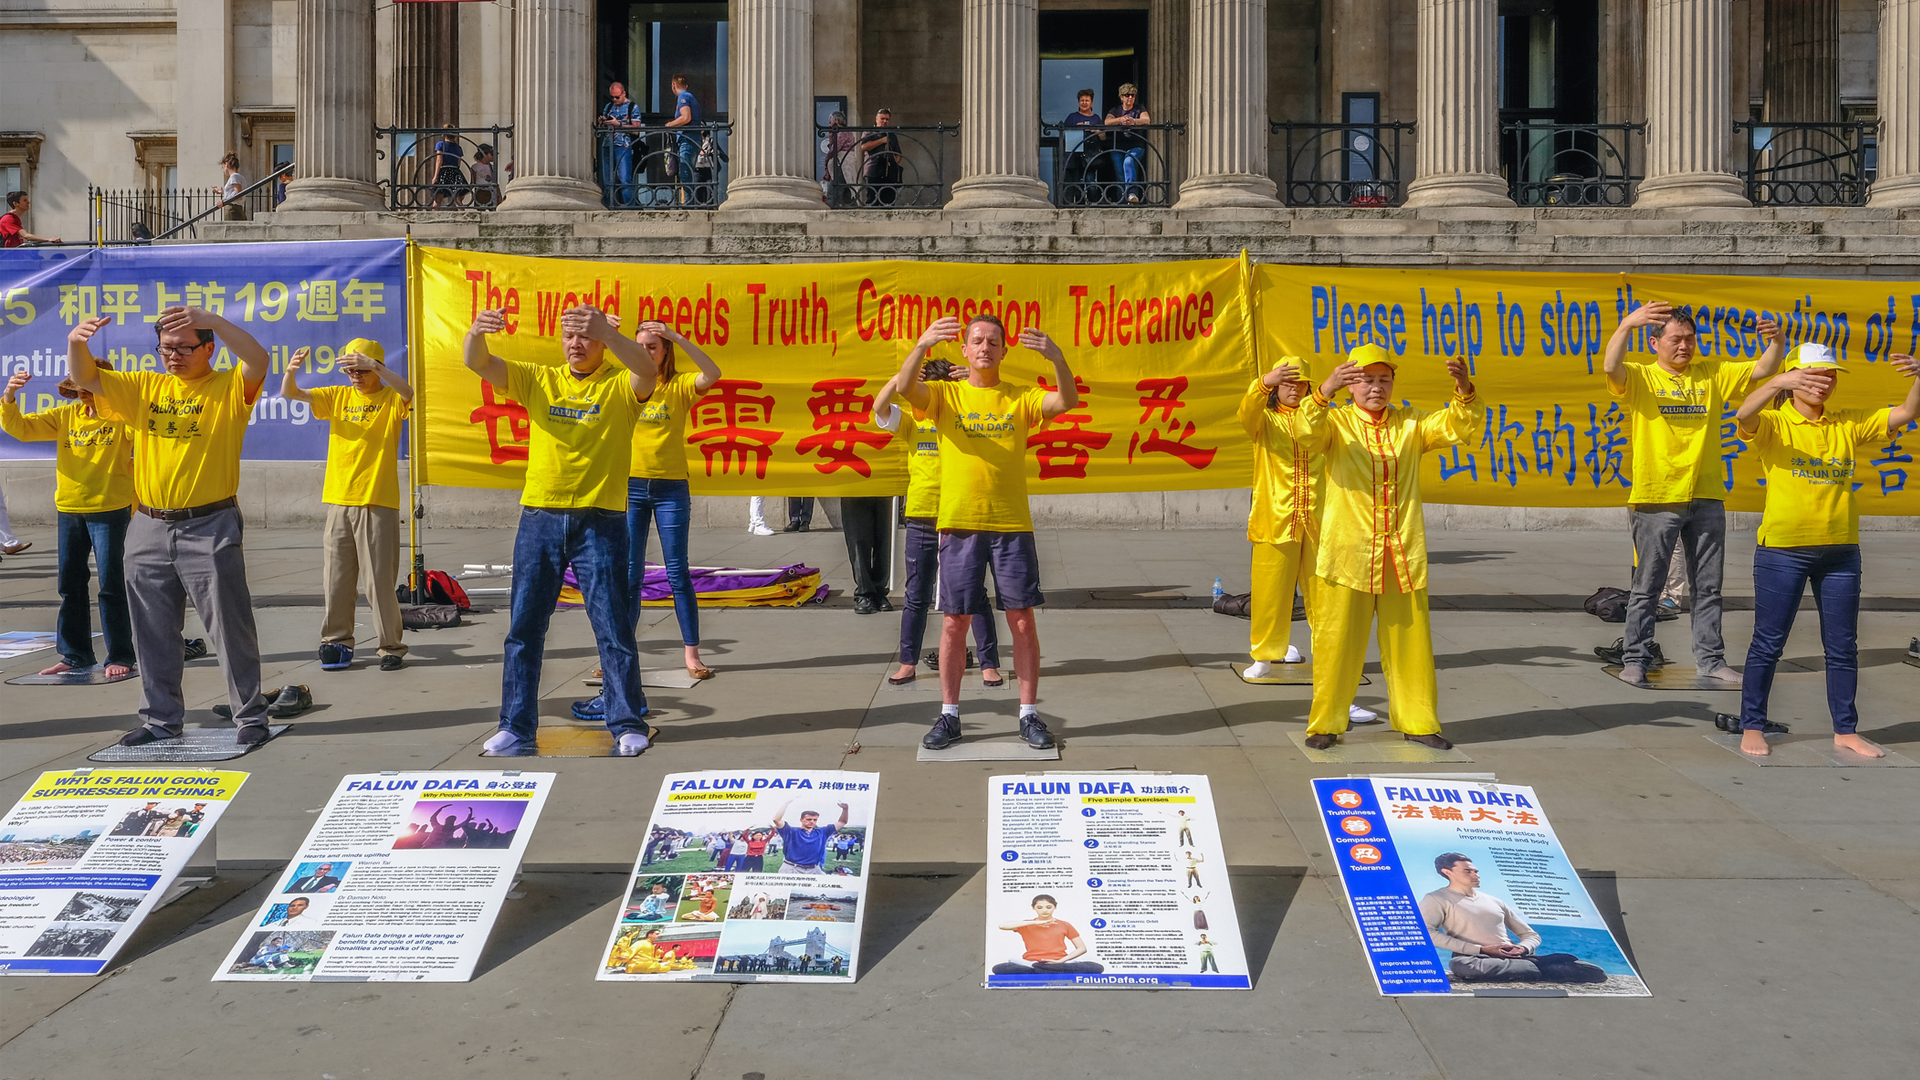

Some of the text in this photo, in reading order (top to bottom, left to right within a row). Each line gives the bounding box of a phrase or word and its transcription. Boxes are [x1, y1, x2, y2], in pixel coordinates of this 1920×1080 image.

[466, 270, 519, 335] The
[537, 279, 620, 337] wld
[638, 283, 730, 346] needs
[747, 282, 838, 357] Truth,
[1069, 284, 1214, 348] Tolerance
[1311, 285, 1407, 357] Please
[1420, 287, 1483, 376] help
[1496, 291, 1526, 357] to
[1540, 290, 1601, 375] stop
[1679, 294, 1850, 362] ersecution
[1865, 295, 1897, 363] of
[108, 347, 156, 373] the
[149, 402, 179, 415] FALUN
[550, 407, 579, 419] FALUN
[954, 421, 1016, 433] FALUN DAFA
[1792, 469, 1829, 479] FALUN
[54, 776, 220, 786] WHY IS FALUN GONG
[346, 780, 419, 792] FALUN
[423, 779, 480, 790] DAFA
[670, 778, 745, 791] FALUN
[752, 778, 813, 789] DAFA
[32, 788, 226, 798] SUPPRESSED IN CHINA?
[1002, 782, 1191, 795] FALUN DAFA 功法簡介
[673, 793, 706, 801] Around
[1383, 786, 1533, 809] FALUN DAFA
[1391, 804, 1539, 826] 法輪大法
[1463, 827, 1504, 835] traditional
[1505, 830, 1535, 838] practice
[1458, 834, 1491, 842] improve
[1530, 838, 1550, 846] body
[1005, 852, 1014, 861] 5
[1090, 879, 1098, 887] 3
[1094, 918, 1102, 927] 4
[1075, 975, 1159, 985] FalunDafa.org
